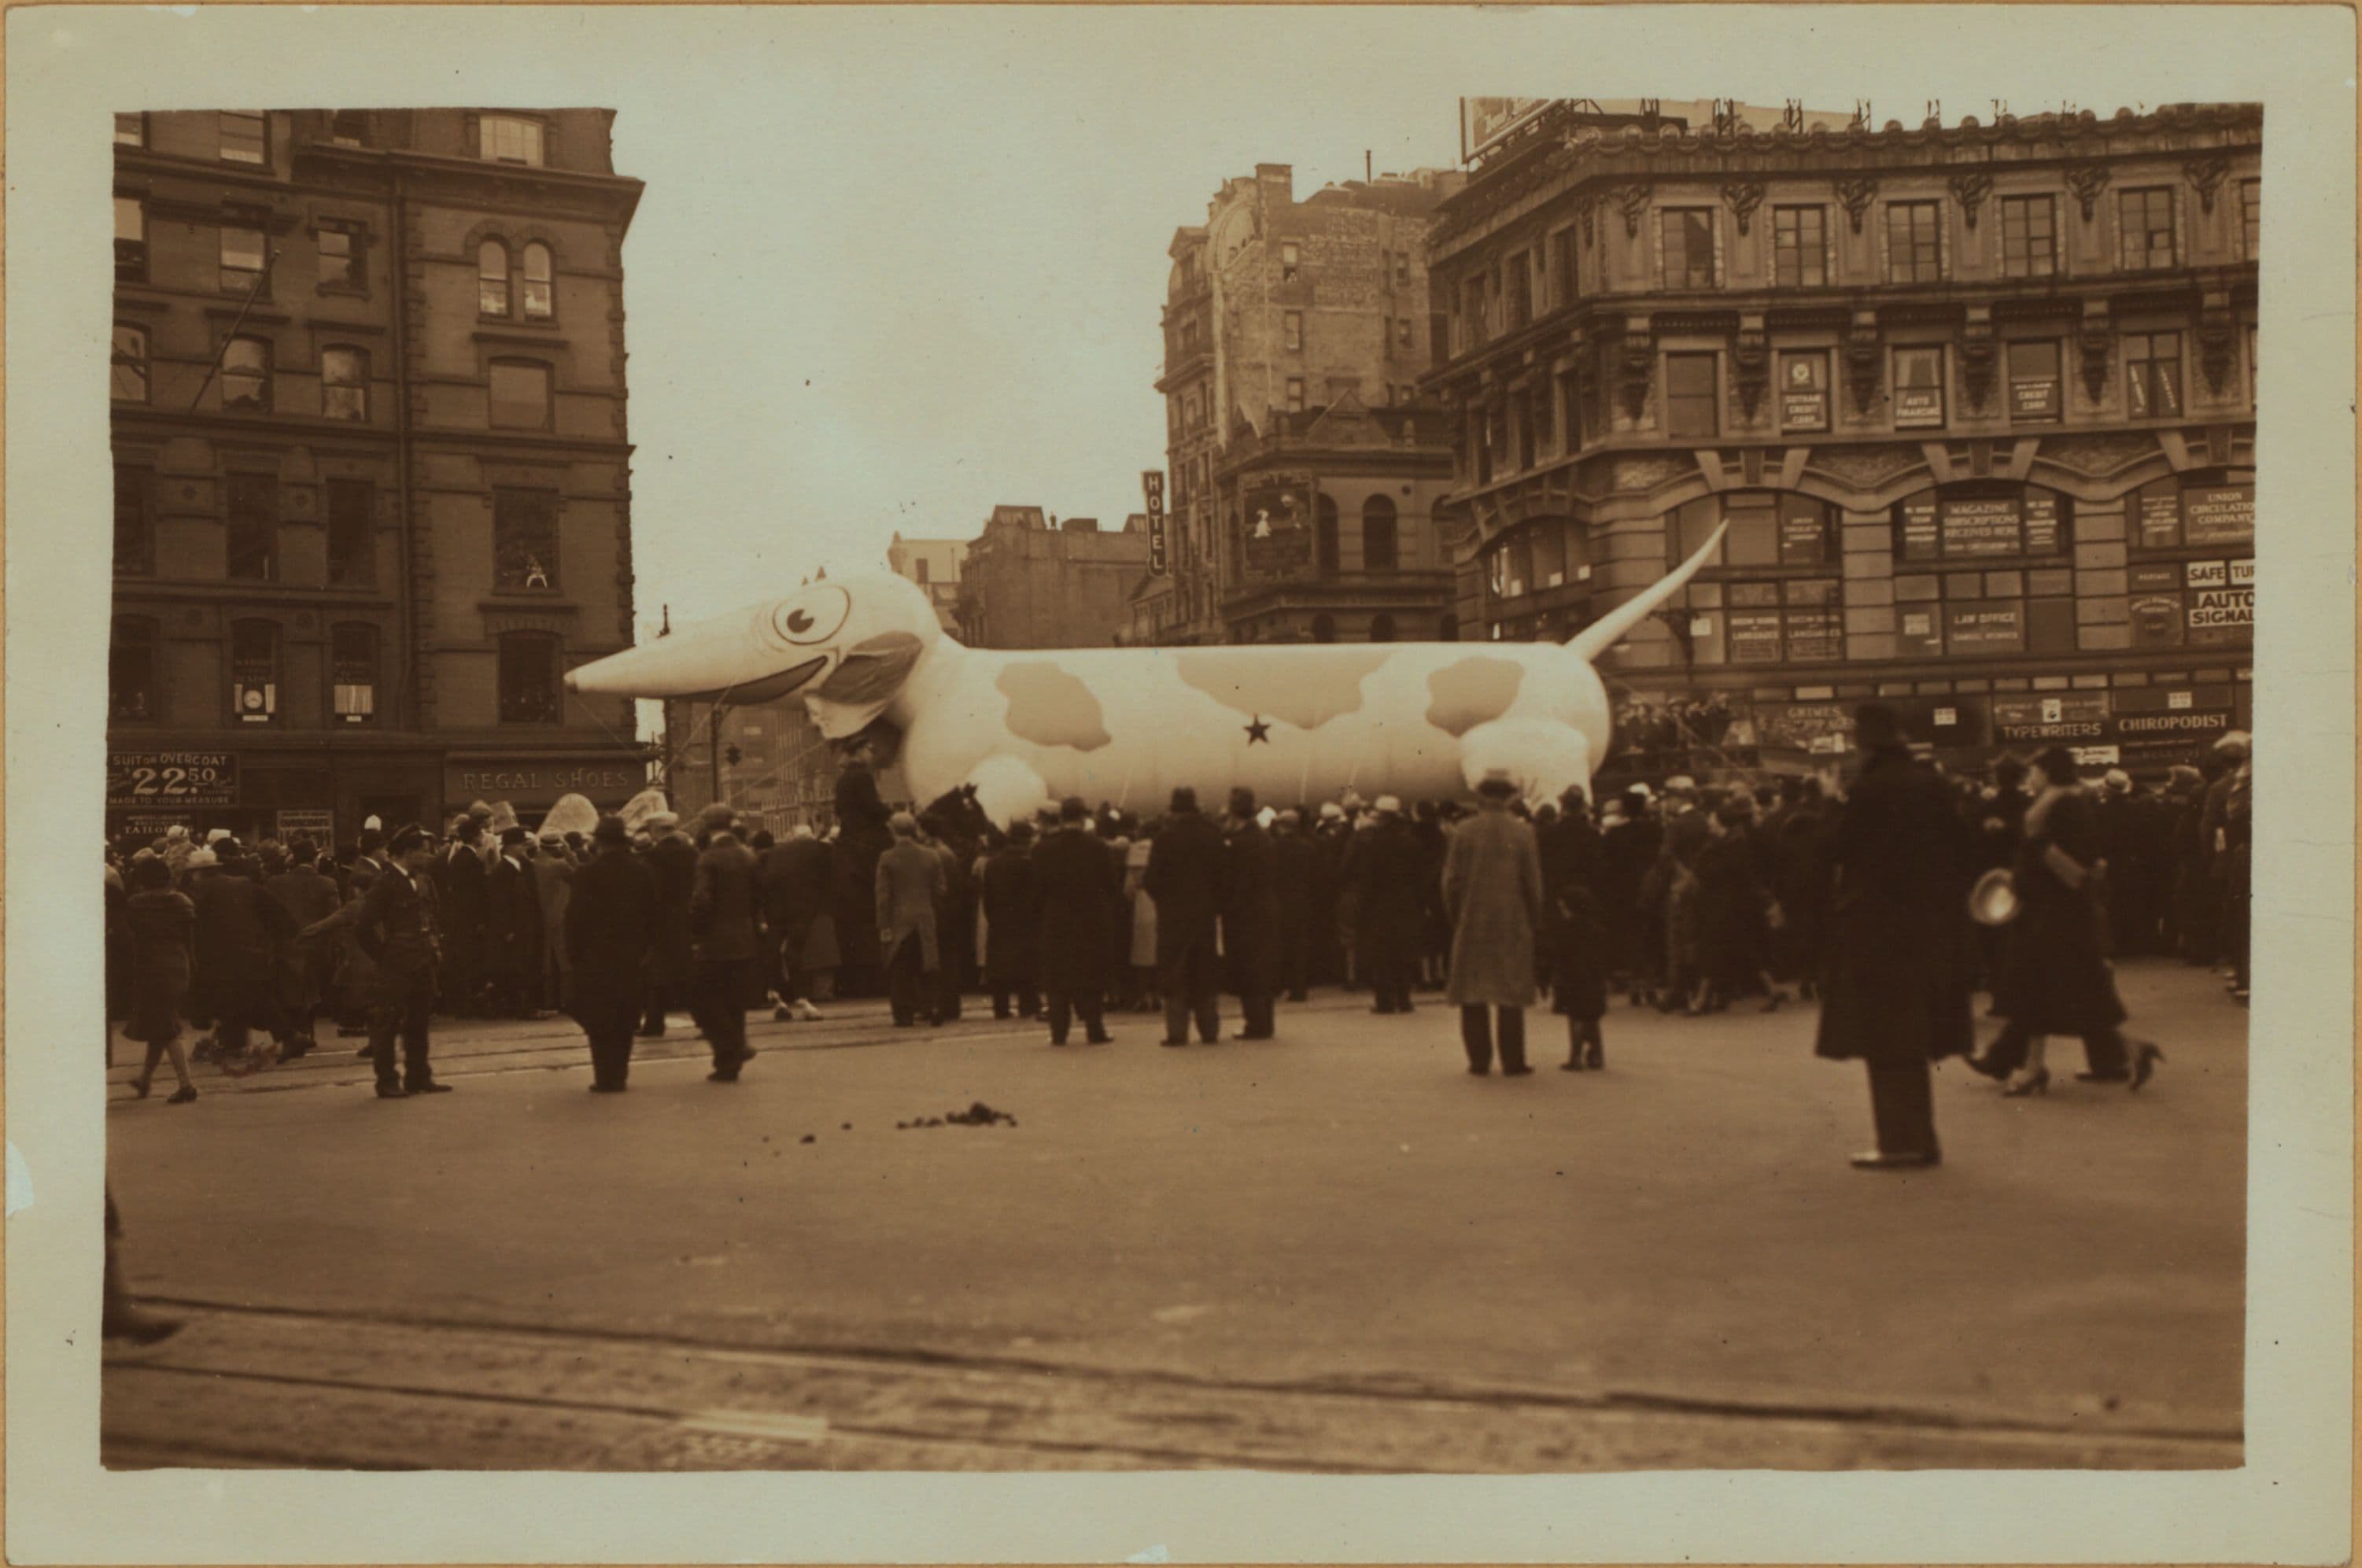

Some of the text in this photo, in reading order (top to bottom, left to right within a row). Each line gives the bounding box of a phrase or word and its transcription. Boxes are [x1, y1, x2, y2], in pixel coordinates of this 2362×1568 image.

[2209, 492, 2242, 503] UNION
[1950, 504, 2009, 515] MAGAZINE
[1149, 475, 1163, 570] HOTEL
[2190, 567, 2224, 581] SAFE
[2002, 722, 2102, 738] TYPEWRITERS
[2119, 714, 2228, 732] CHIROPODIST
[113, 755, 142, 766] SUIT
[160, 753, 227, 766] OVERCOAT
[463, 768, 629, 789] REGAL SHOES
